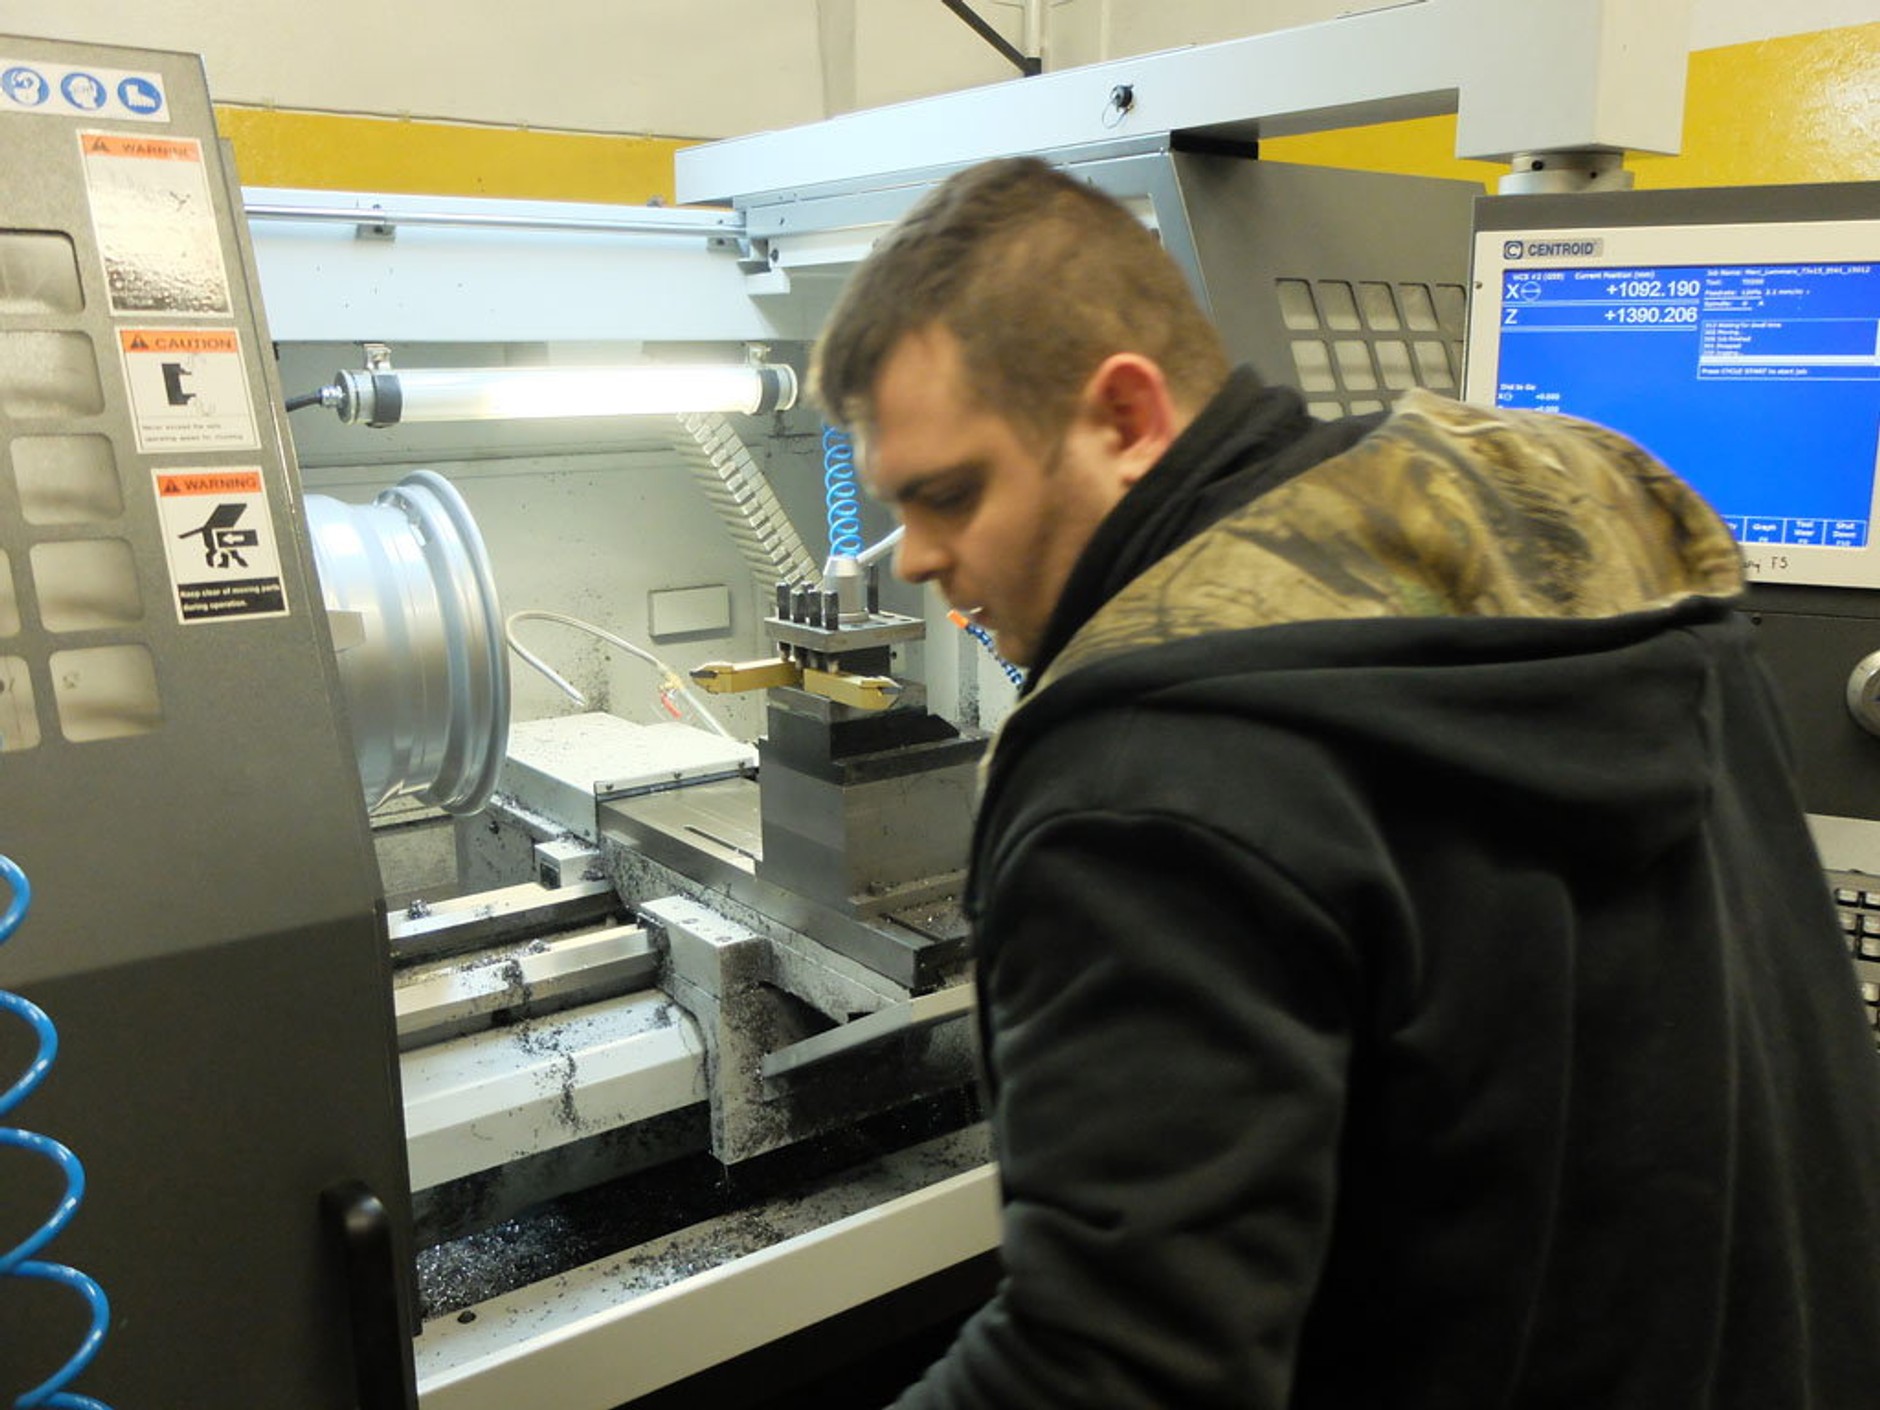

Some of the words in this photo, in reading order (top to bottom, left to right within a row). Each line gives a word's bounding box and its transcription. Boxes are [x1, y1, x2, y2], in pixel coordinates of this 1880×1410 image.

[1528, 242, 1594, 257] CENTROID
[1575, 272, 1602, 280] Current
[1505, 283, 1520, 299] X
[1606, 280, 1700, 298] +1092.190
[1504, 308, 1518, 324] Z
[1604, 306, 1698, 324] +1390.206
[154, 337, 232, 350] CAUTION
[185, 476, 258, 492] WARNING
[180, 590, 202, 600] Keep
[202, 588, 222, 597] clear
[222, 587, 232, 596] of
[183, 602, 210, 612] during
